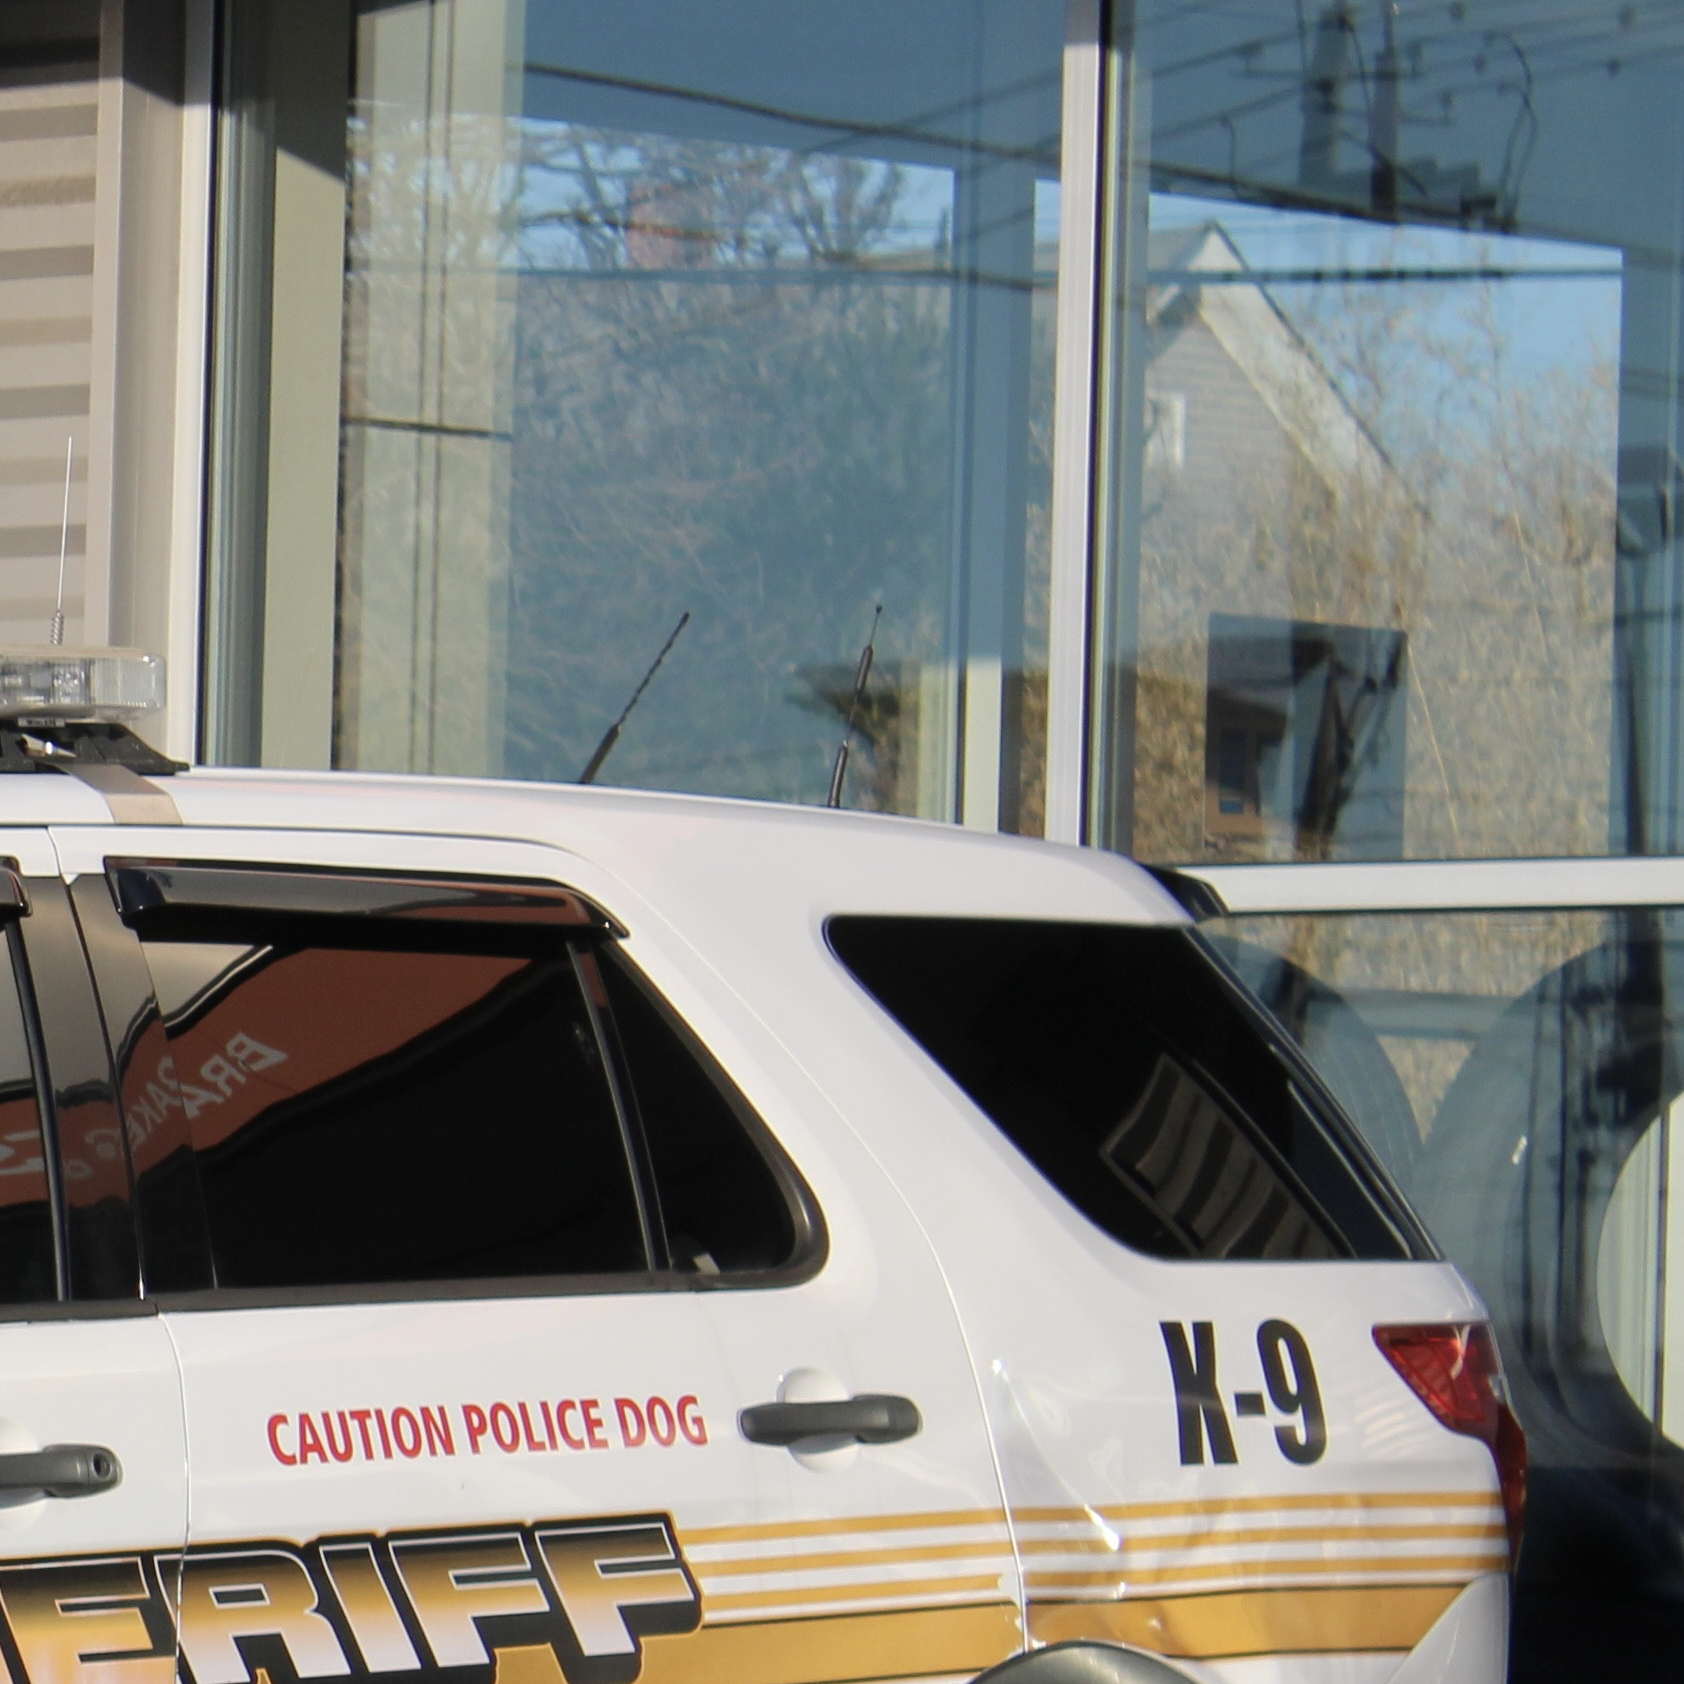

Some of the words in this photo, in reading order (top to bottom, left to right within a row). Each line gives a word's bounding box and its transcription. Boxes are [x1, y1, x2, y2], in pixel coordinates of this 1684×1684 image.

[266, 1404, 456, 1466] CAUTION
[461, 1398, 609, 1455] POLICE
[614, 1394, 708, 1449] DOG
[1159, 1318, 1327, 1465] K-9
